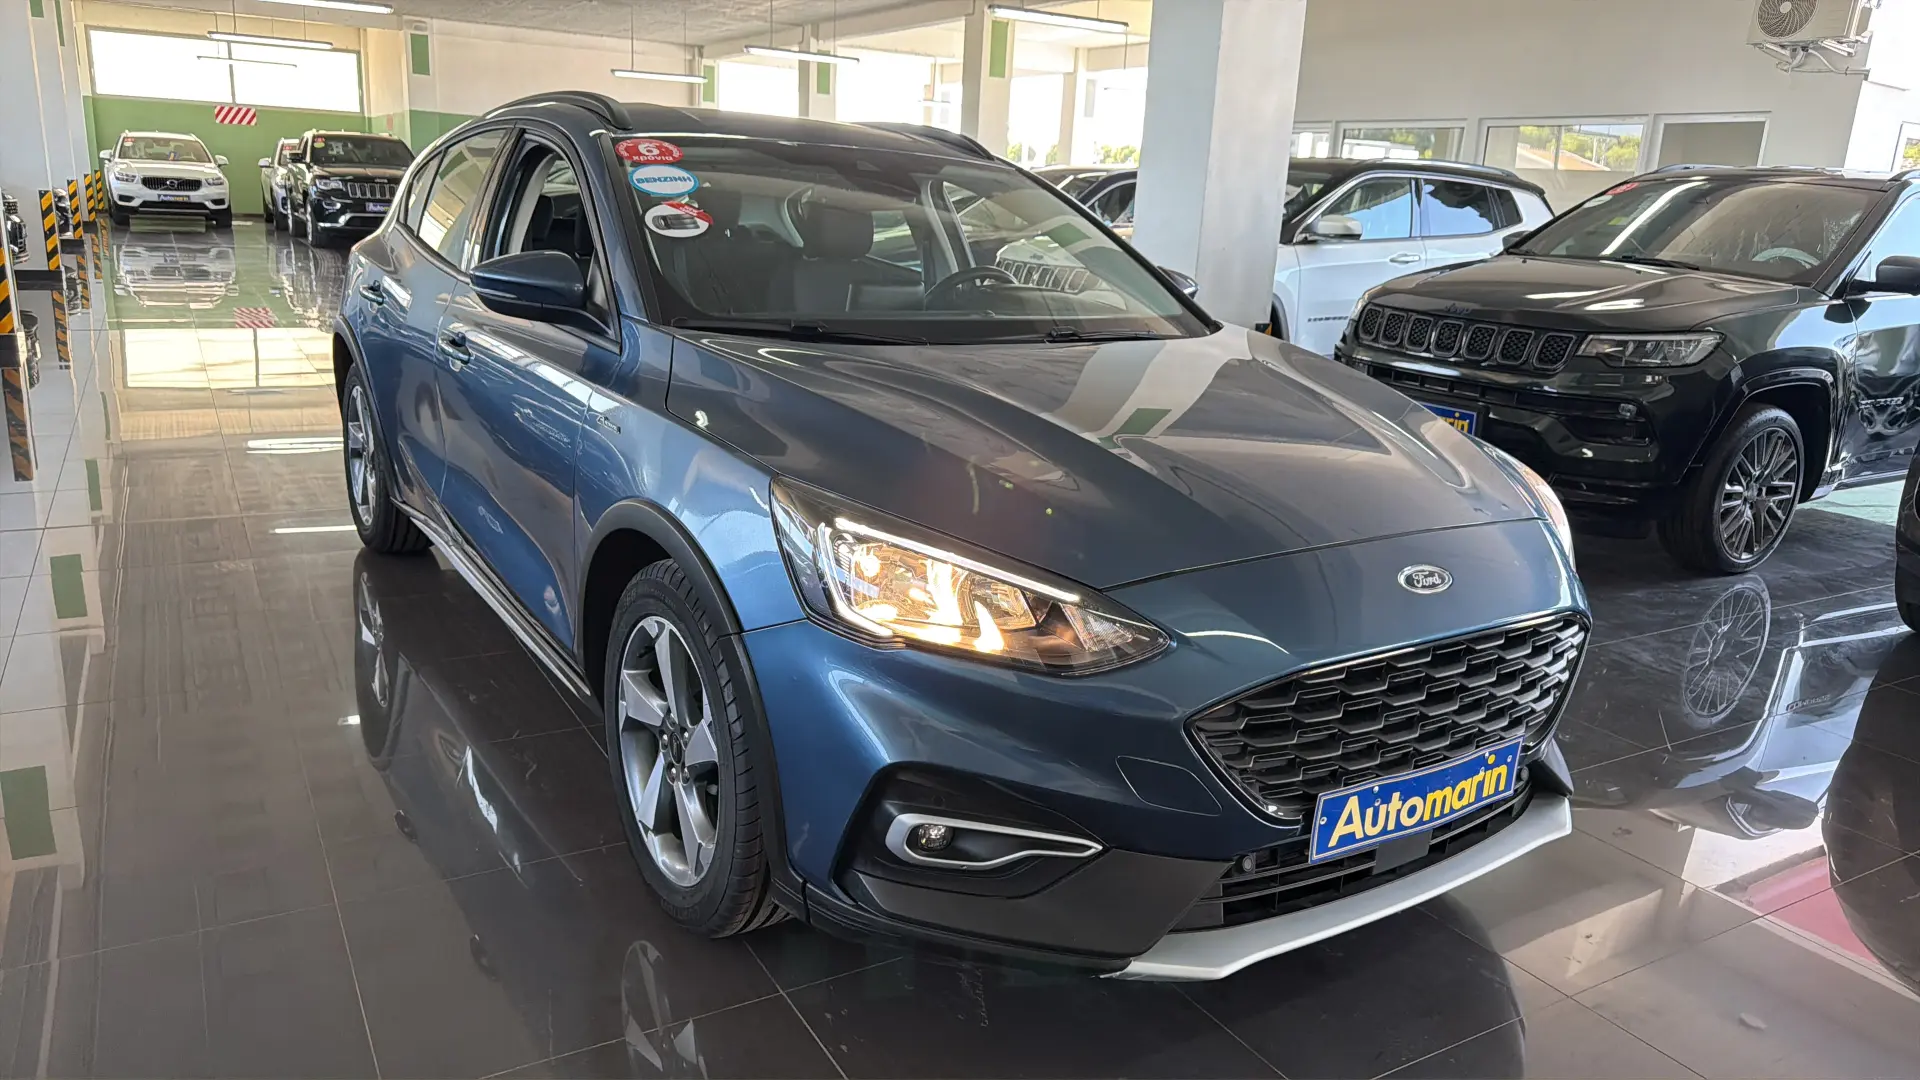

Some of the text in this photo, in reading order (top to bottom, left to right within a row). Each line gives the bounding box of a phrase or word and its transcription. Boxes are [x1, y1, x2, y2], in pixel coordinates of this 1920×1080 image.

[637, 142, 660, 156] 6
[1412, 571, 1442, 588] Ford
[1327, 754, 1508, 848] Automarin
